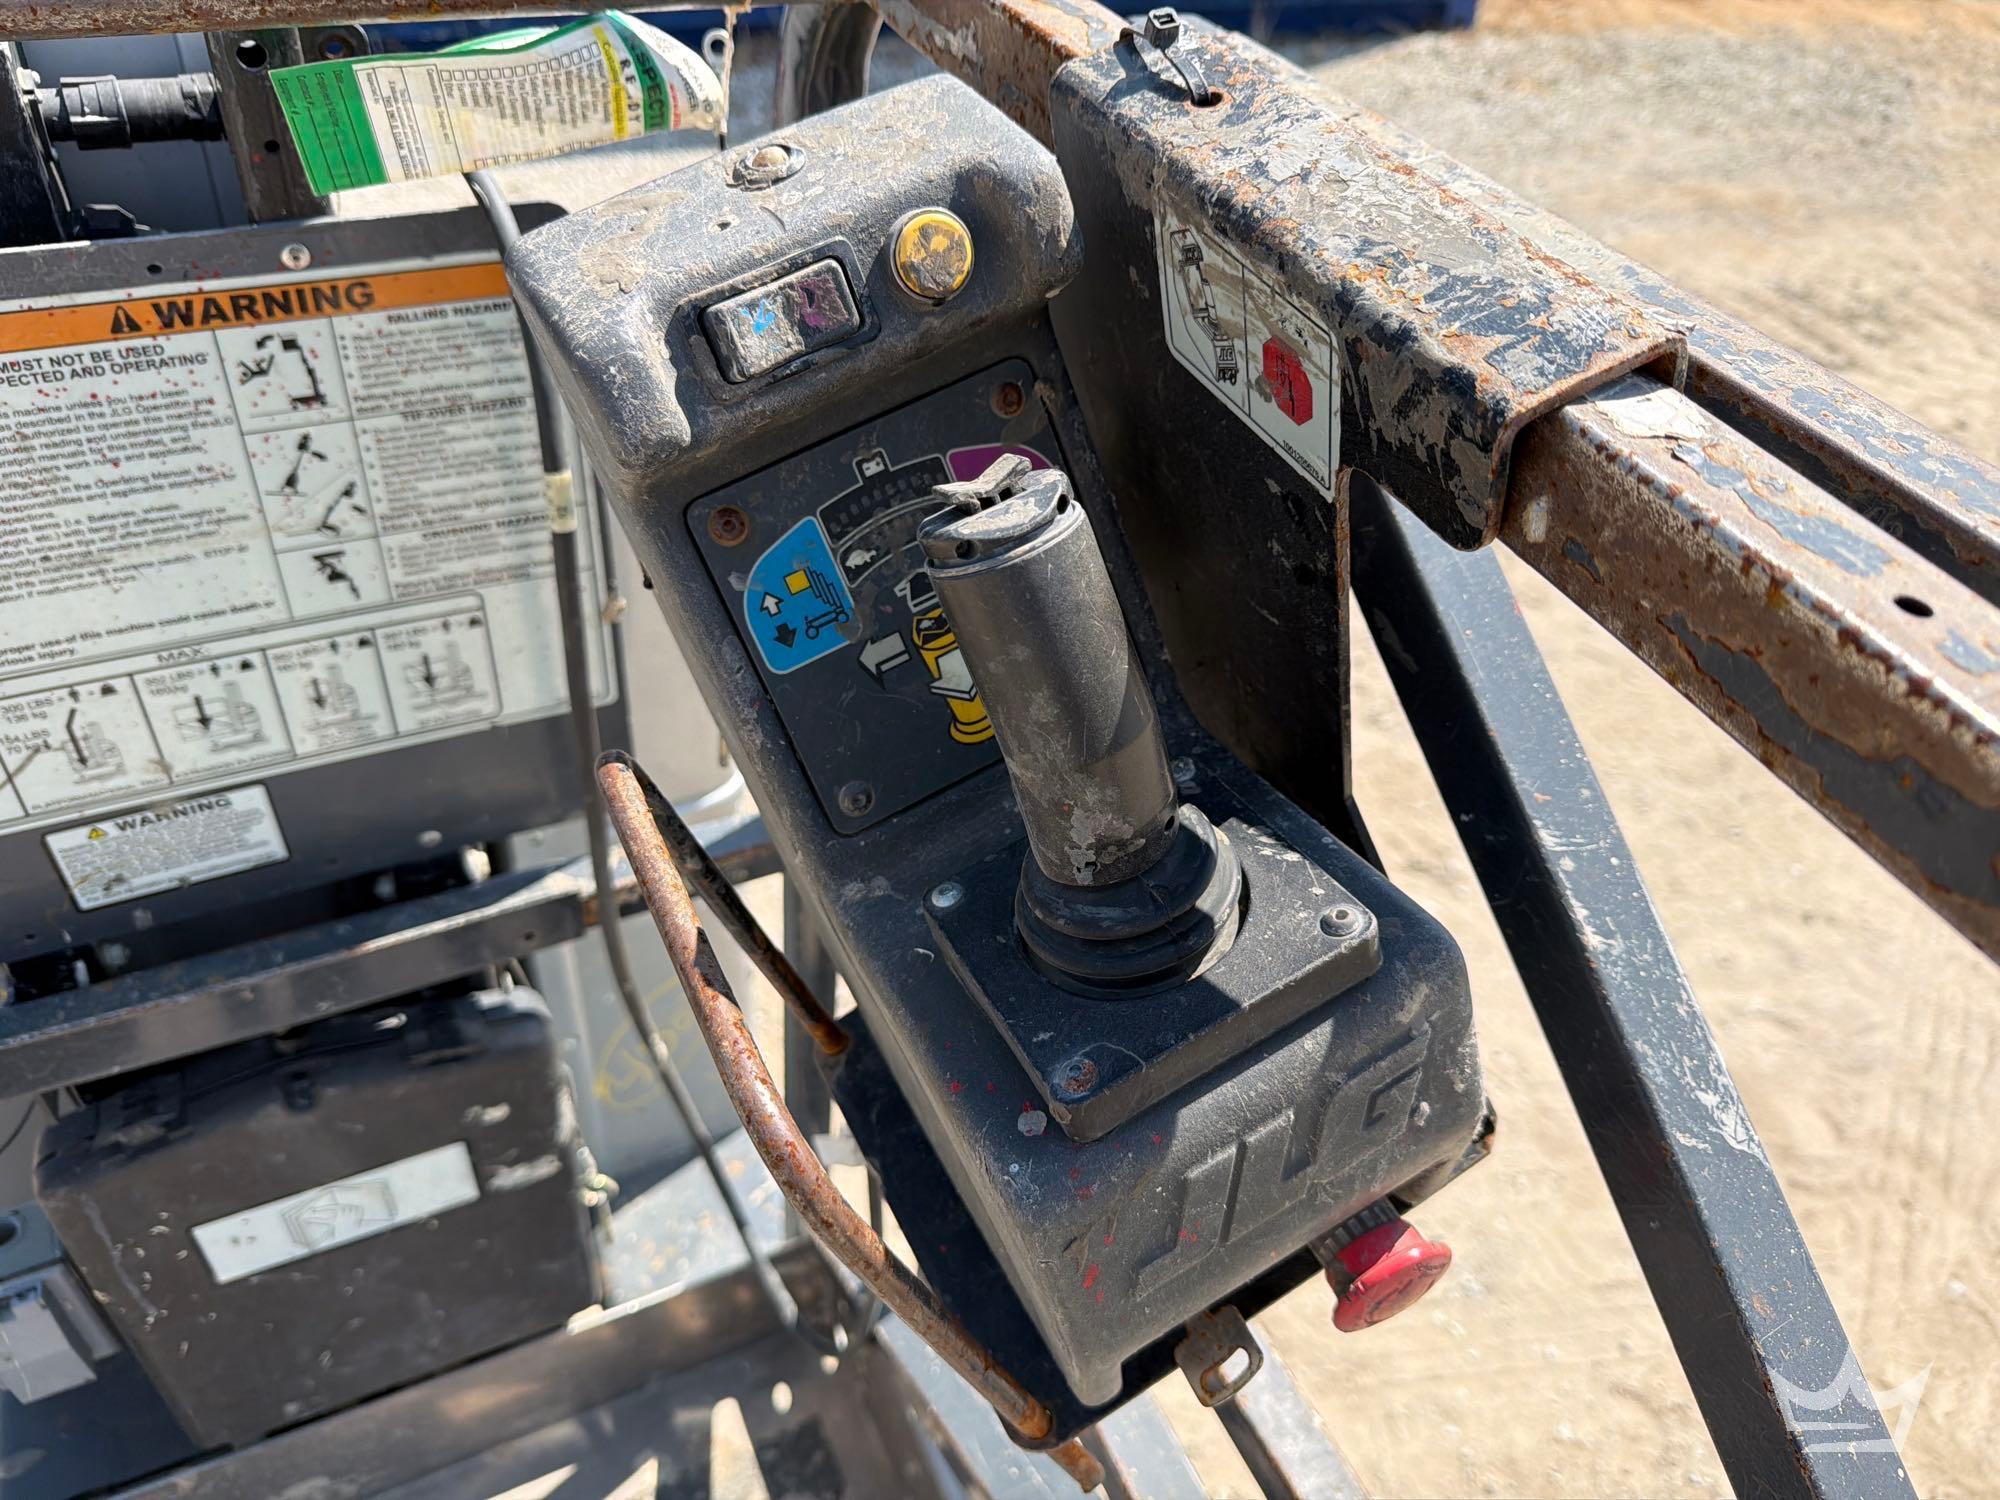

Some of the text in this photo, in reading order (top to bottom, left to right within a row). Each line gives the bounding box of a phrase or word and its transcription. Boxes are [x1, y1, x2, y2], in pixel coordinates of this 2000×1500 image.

[150, 281, 375, 329] WARNING
[0, 343, 166, 374] MUST NOT BE USED
[67, 364, 107, 380] AND
[108, 352, 209, 375] OPERATING
[11, 403, 63, 416] machine
[64, 398, 103, 410] unless
[13, 414, 72, 430] described
[114, 796, 233, 832] WARNING
[1130, 1017, 1435, 1303] JLG
